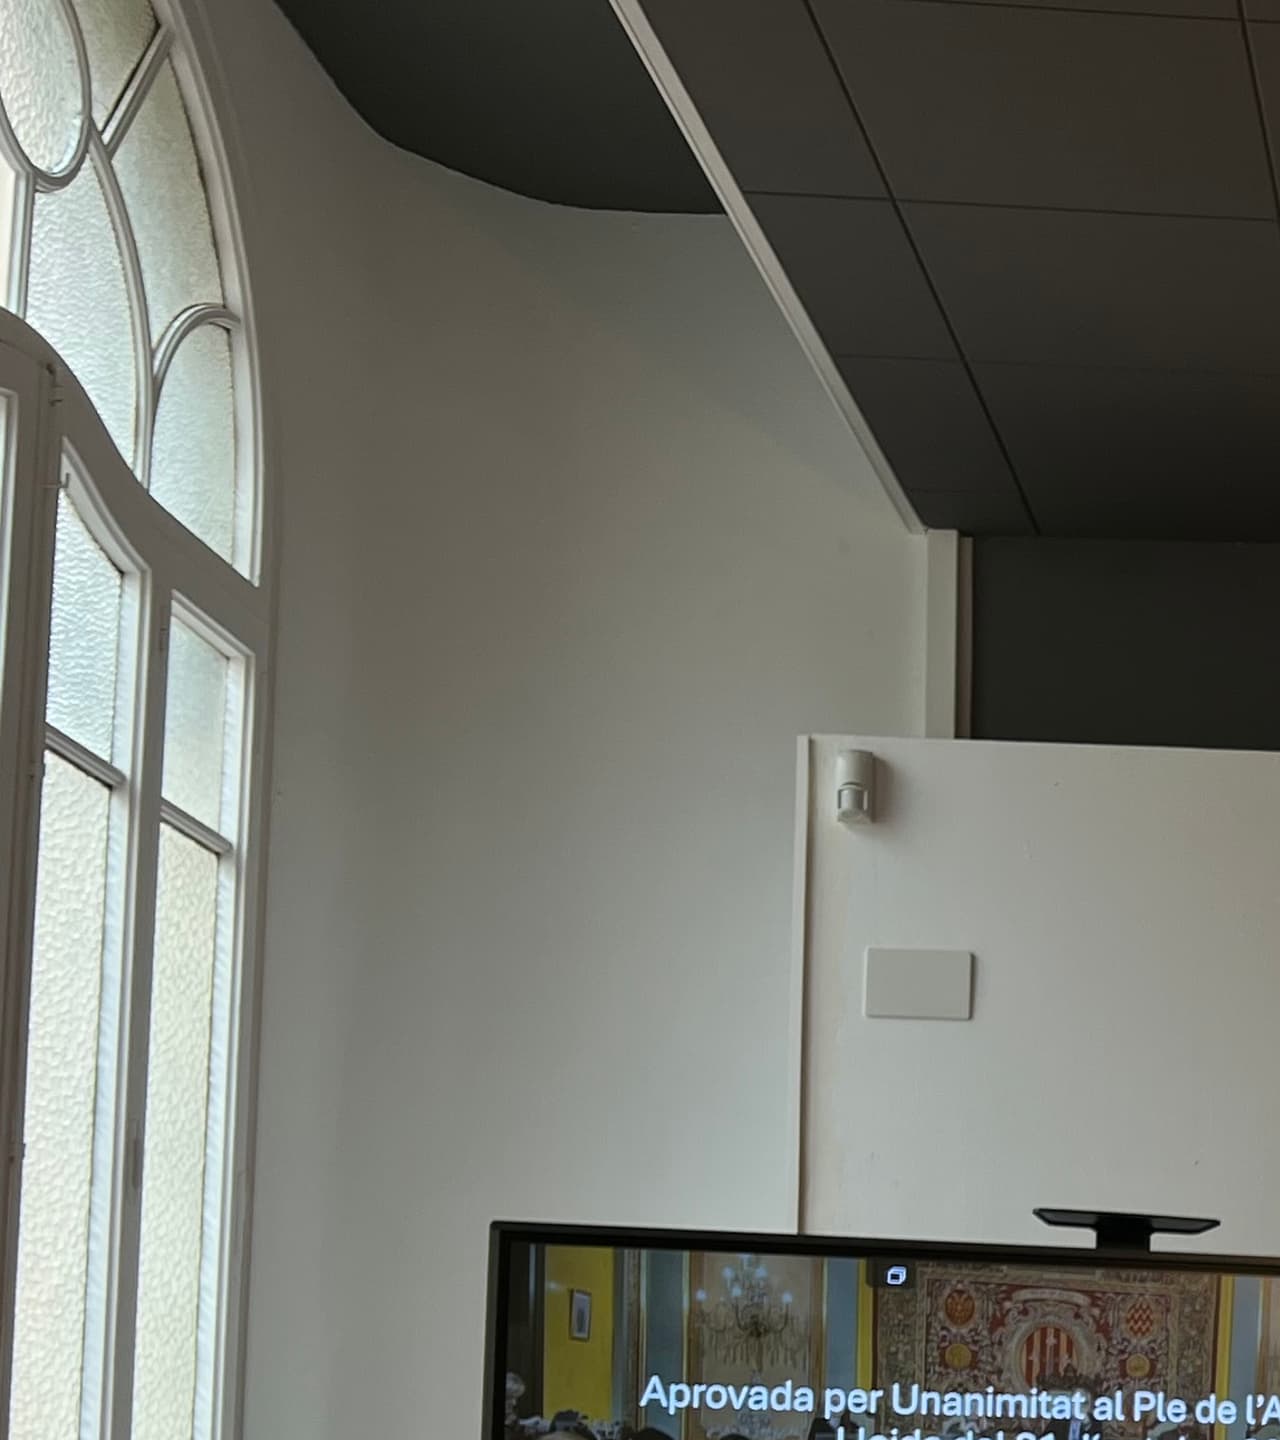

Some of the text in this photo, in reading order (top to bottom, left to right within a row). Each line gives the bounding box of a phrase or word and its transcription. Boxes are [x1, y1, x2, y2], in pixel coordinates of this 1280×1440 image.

[640, 1374, 813, 1416] Aprovada
[824, 1387, 883, 1420] per
[891, 1383, 1085, 1421] Unanimitat
[1093, 1391, 1124, 1422] al
[1133, 1390, 1187, 1424] Ple
[1195, 1393, 1237, 1425] de
